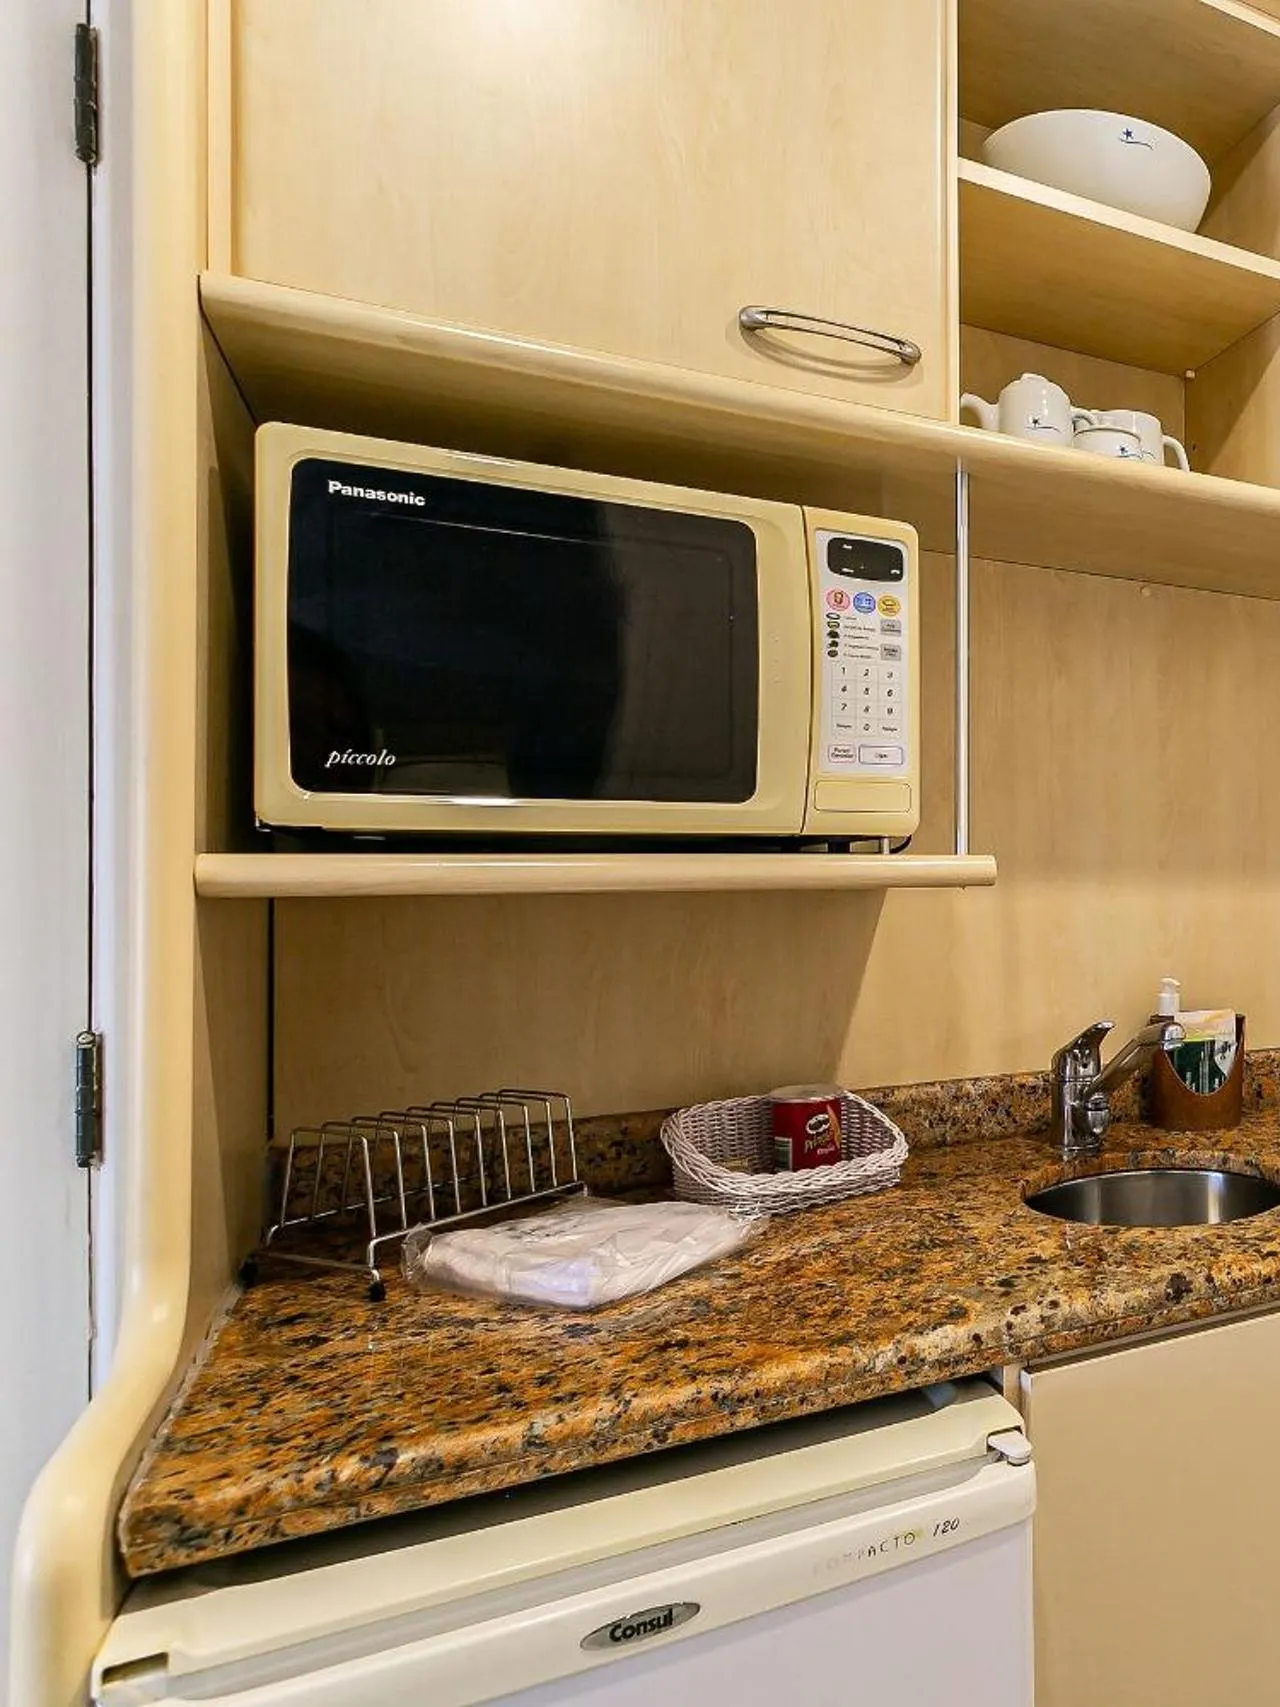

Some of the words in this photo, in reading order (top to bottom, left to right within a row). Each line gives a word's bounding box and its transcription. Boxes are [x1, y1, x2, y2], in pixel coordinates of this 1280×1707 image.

[328, 480, 426, 506] Panasonic
[813, 1532, 915, 1576] OPACTO
[933, 1517, 960, 1537] 120
[609, 1608, 673, 1642] Consul
